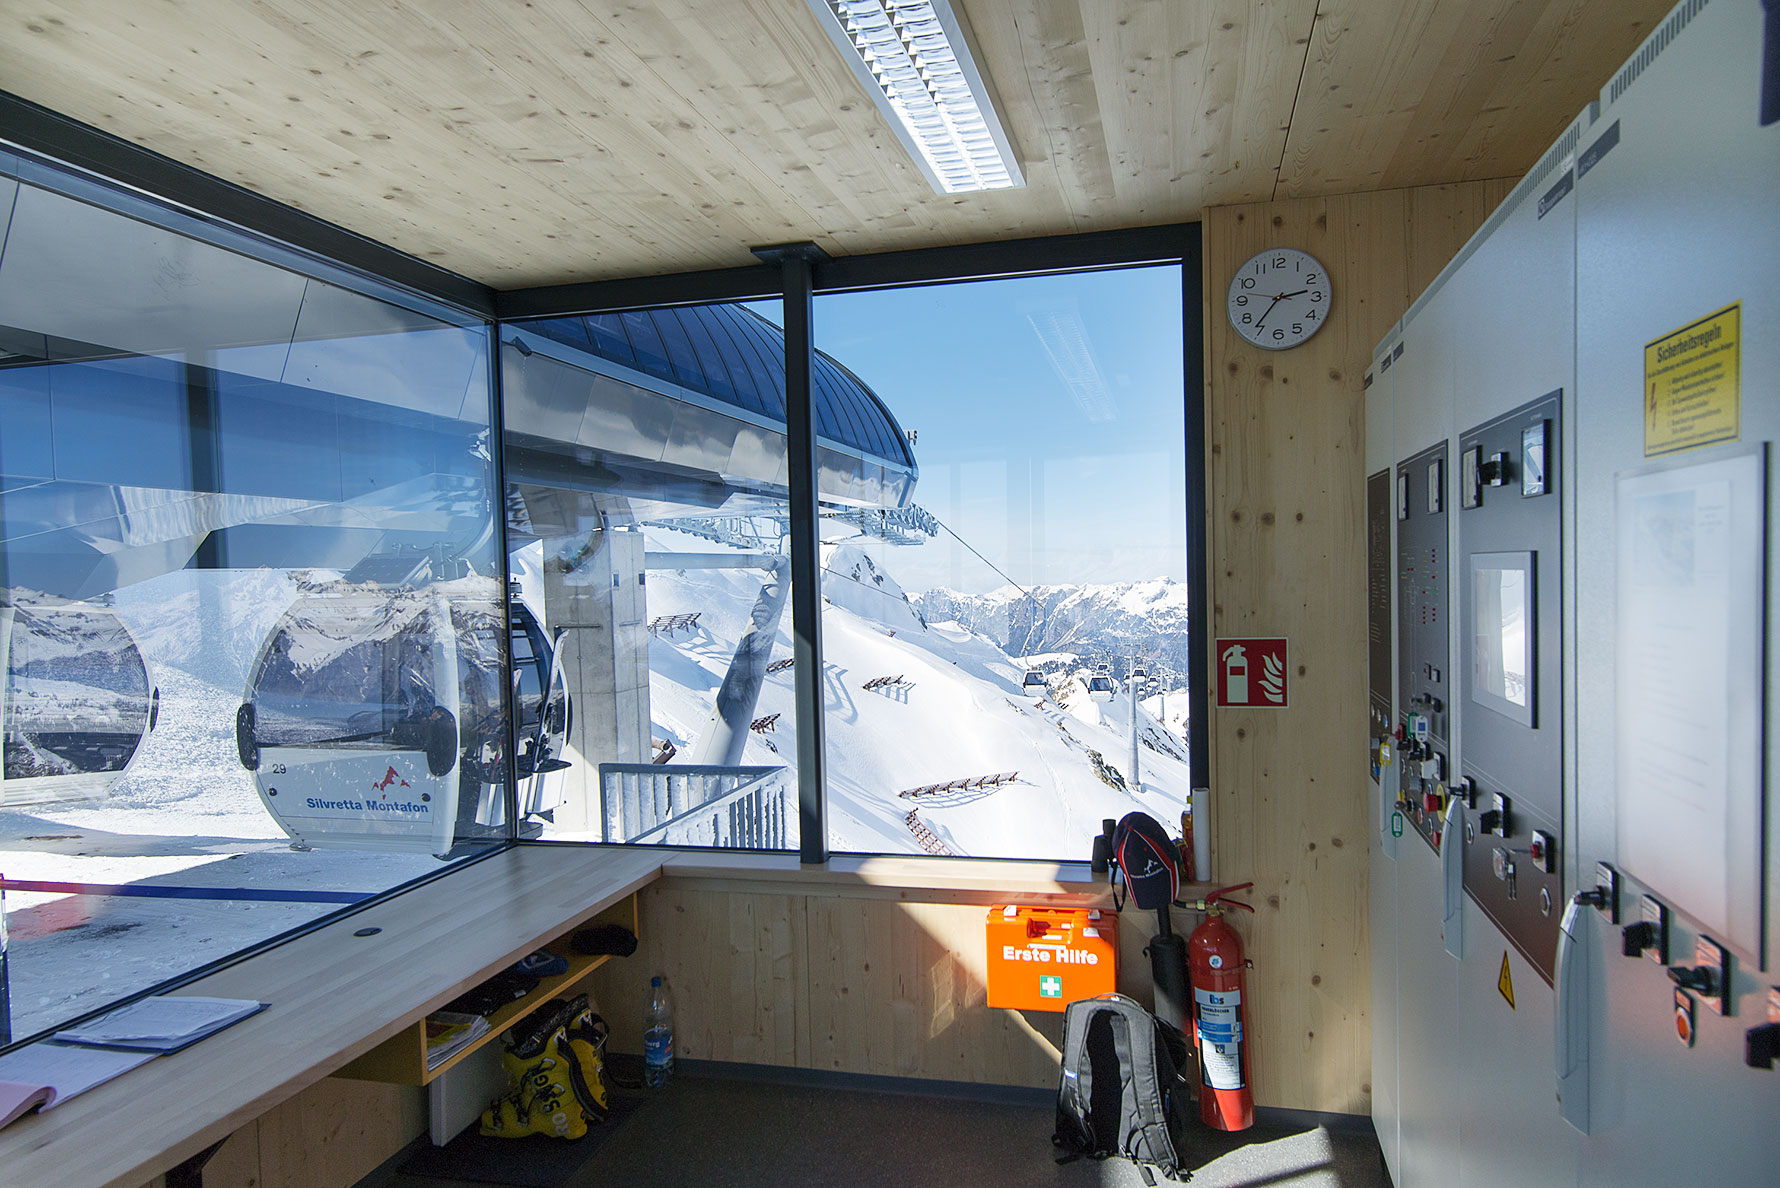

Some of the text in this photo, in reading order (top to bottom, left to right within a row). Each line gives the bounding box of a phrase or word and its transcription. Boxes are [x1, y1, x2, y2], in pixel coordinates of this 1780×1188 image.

[1255, 263, 1266, 275] 11
[1272, 257, 1287, 269] 12
[1296, 261, 1300, 273] 1
[1241, 277, 1256, 290] 10
[1306, 273, 1317, 285] 2
[1236, 295, 1249, 307] 9
[1310, 290, 1322, 303] 3
[1242, 312, 1253, 325] 8
[1305, 309, 1317, 321] 4
[1255, 325, 1265, 337] 7
[1272, 328, 1285, 340] 6
[1292, 323, 1303, 334] 5
[1657, 323, 1722, 364] Sicherheitsregeln
[272, 763, 287, 774] 29
[306, 797, 429, 813] Silvretta Montafon
[1002, 945, 1099, 965] Erste Hilfe
